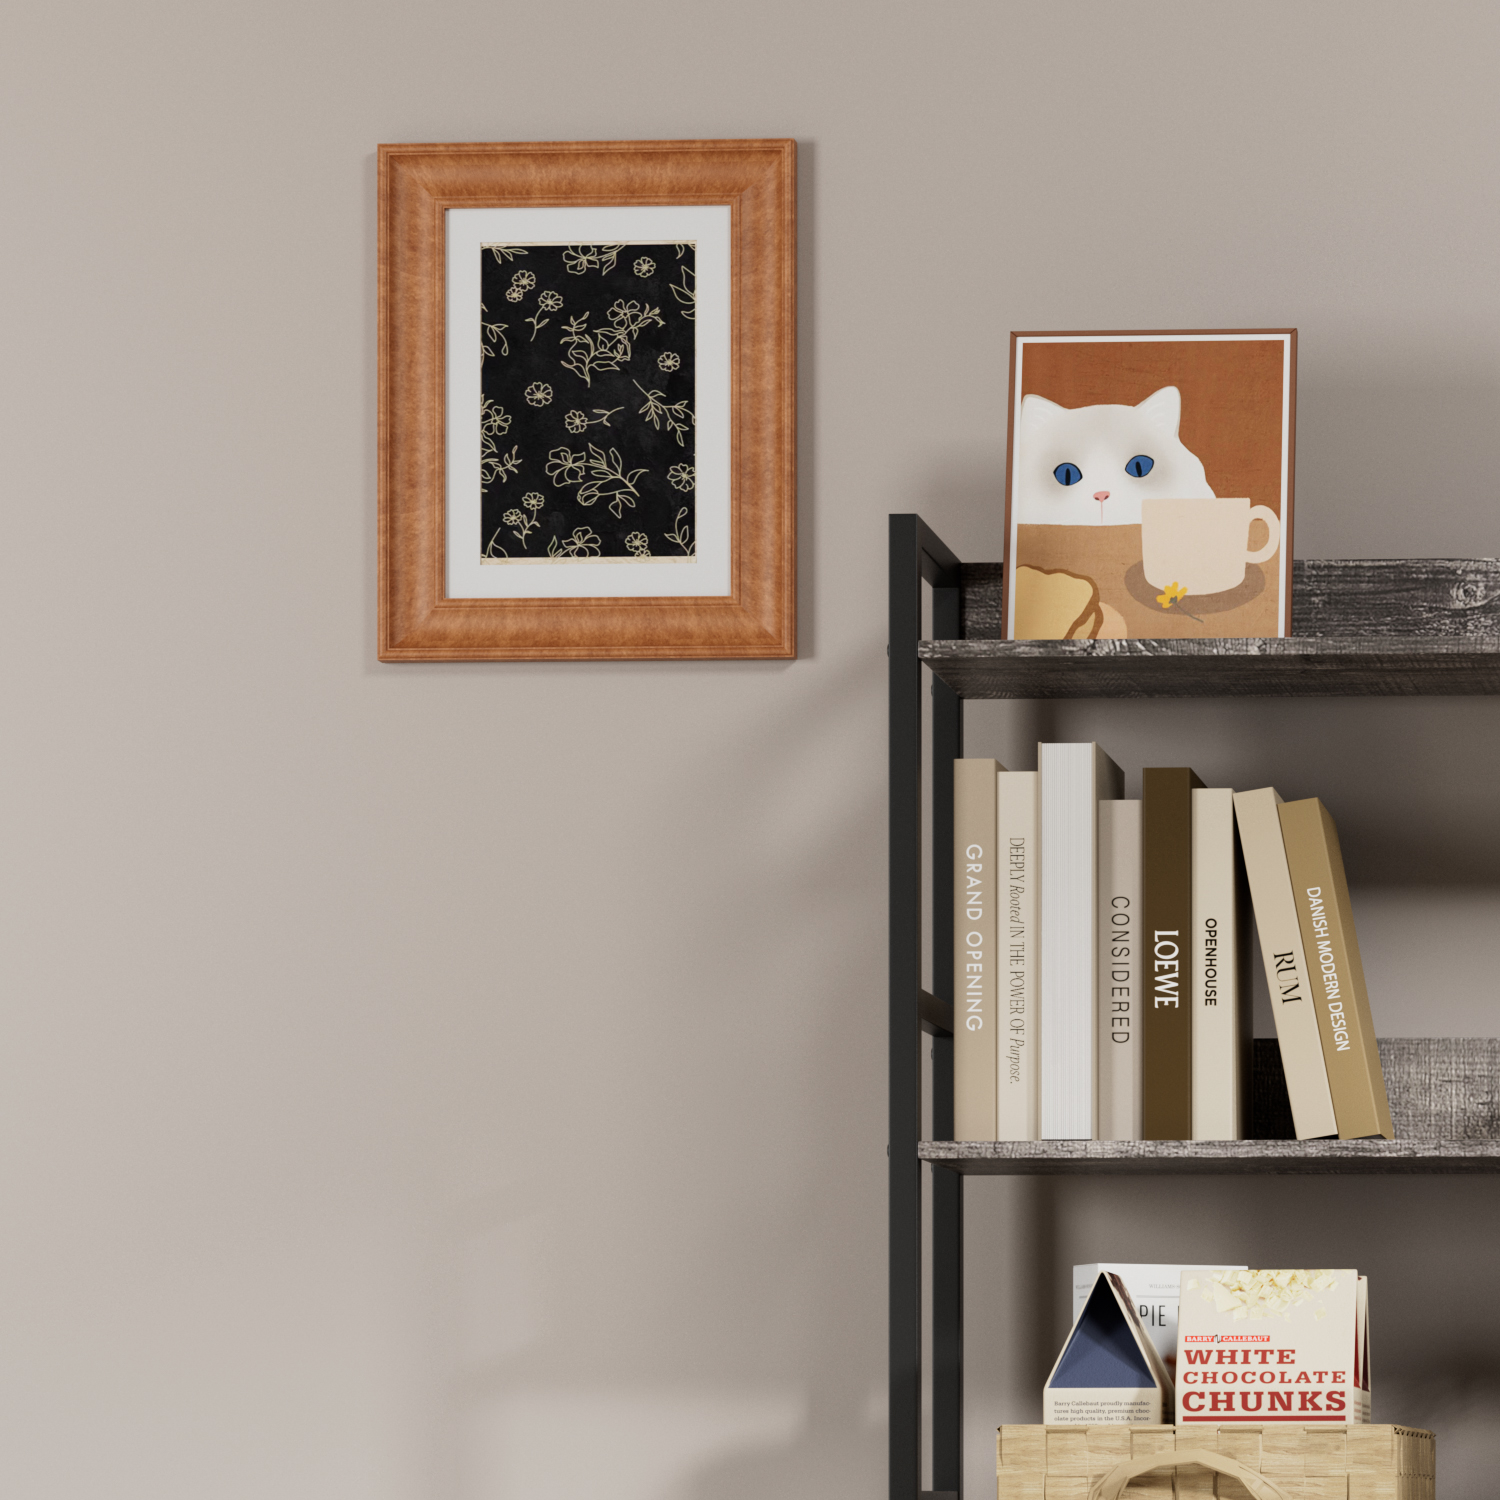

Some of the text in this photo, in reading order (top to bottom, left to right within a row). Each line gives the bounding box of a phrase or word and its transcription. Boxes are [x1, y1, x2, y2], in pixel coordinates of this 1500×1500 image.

[965, 843, 983, 1032] GRAND OPENING
[1006, 837, 1025, 1084] DEEPLY Rooted IN THE POWER OF Purpose.
[1111, 896, 1130, 1044] CONSIDERED
[1154, 930, 1179, 1009] LOEWE
[1204, 918, 1218, 1007] OPENHOUSE
[1273, 949, 1302, 1005] RUM
[1306, 886, 1351, 1052] DANISH MODERN DESIGN
[1139, 1304, 1167, 1327] PIE
[1183, 1370, 1346, 1384] CHOCOLATE
[1184, 1349, 1296, 1365] WHITE
[1182, 1390, 1346, 1413] CHUNKS
